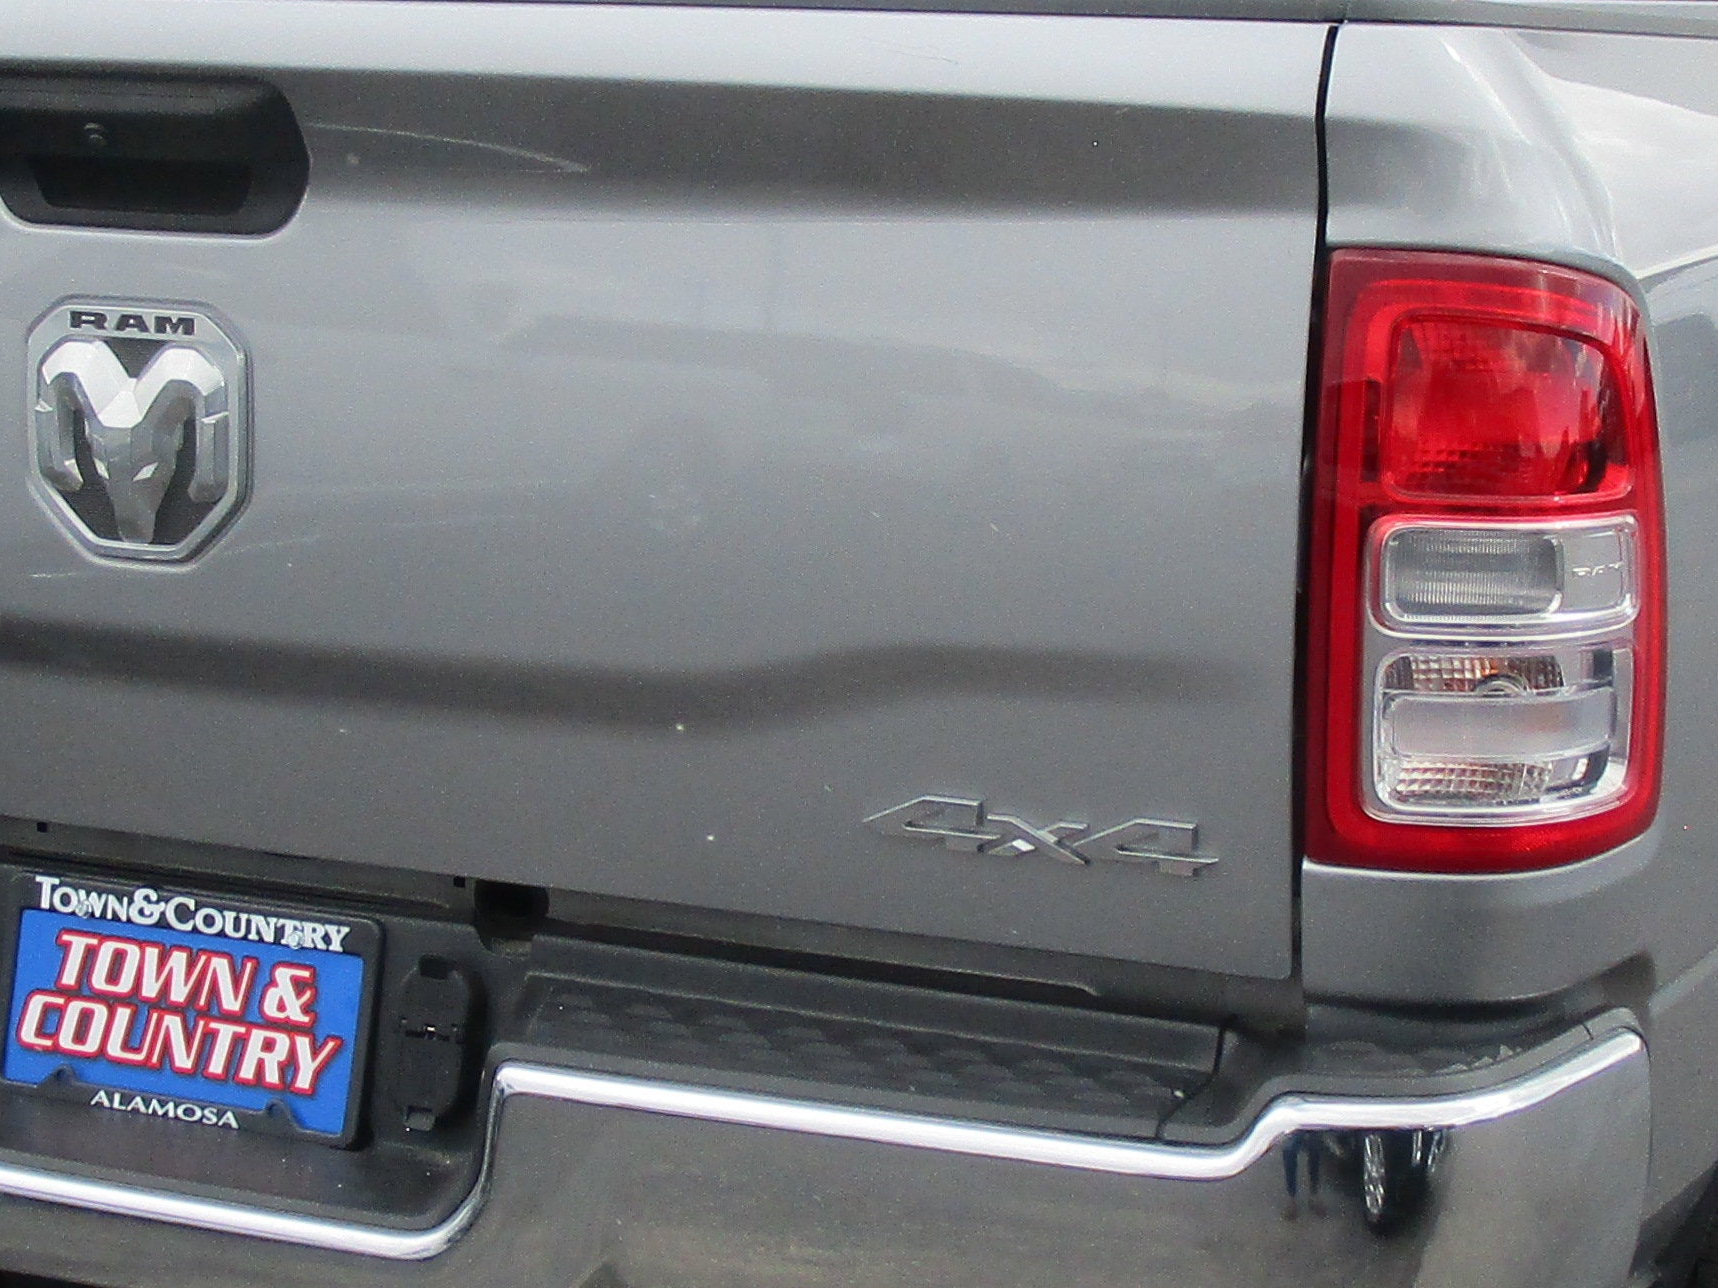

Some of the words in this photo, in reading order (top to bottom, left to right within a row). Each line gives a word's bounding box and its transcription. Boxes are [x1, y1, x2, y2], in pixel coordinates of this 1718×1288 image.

[69, 310, 196, 336] RAM
[56, 929, 259, 1016] TOWN
[261, 963, 317, 1028] &
[16, 989, 344, 1095] COUNTRY
[90, 1089, 240, 1130] ALAMOSA
